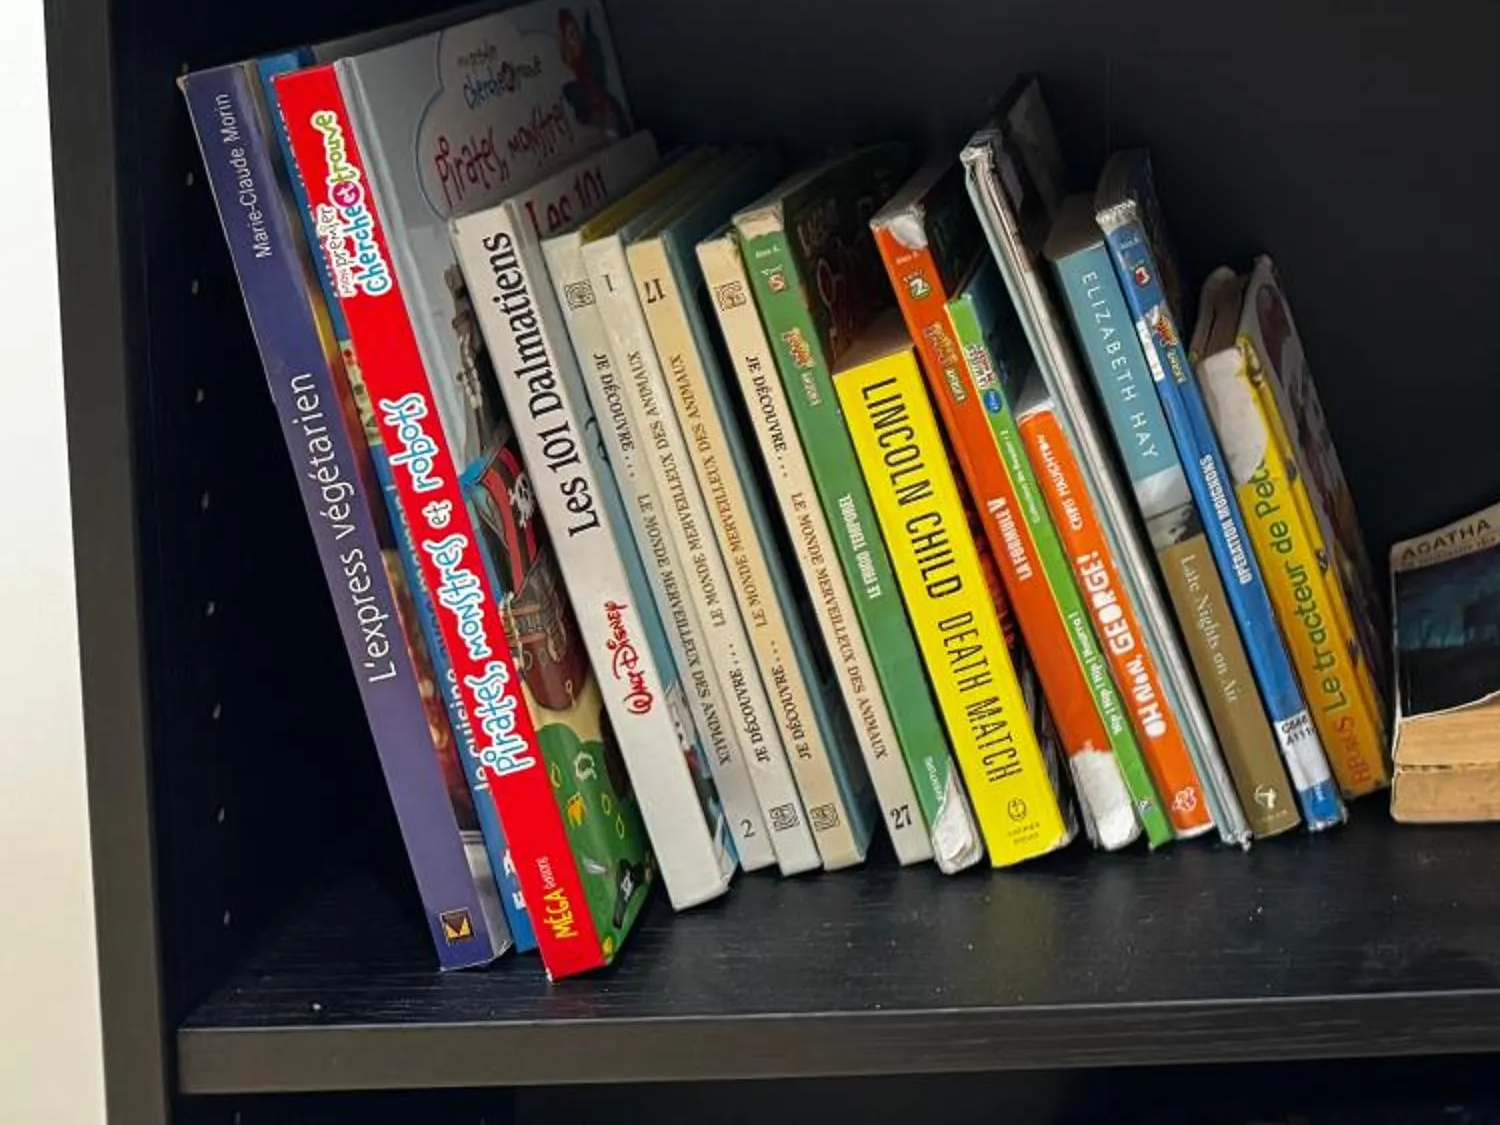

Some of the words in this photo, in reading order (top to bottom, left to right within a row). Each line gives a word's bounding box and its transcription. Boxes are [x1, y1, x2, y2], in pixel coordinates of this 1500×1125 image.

[216, 91, 242, 144] Morin
[310, 109, 358, 189] trouve
[230, 143, 272, 260] Marie-Claude
[483, 232, 563, 420] Dalmatiens
[626, 350, 660, 419] ANIMAUX
[669, 352, 702, 421] ANIMAUX
[744, 354, 762, 373] JE
[1082, 270, 1138, 403] ELIZABETH
[1130, 412, 1160, 461] HAY
[290, 373, 357, 544] végétarien
[538, 421, 583, 475] 101
[648, 420, 670, 458] DES
[691, 421, 712, 459] DES
[861, 375, 935, 507] LINCOLN
[422, 499, 453, 530] et
[560, 476, 601, 538] Les
[637, 493, 655, 514] LE
[789, 491, 806, 512] LE
[641, 516, 671, 570] MONDE
[796, 512, 826, 567] MONDE
[904, 510, 963, 601] CHILD
[1268, 520, 1296, 556] de
[1400, 516, 1492, 561] AGATHA
[692, 551, 721, 606] MONDE
[735, 553, 762, 607] MONDE
[1178, 553, 1200, 591] Late
[336, 547, 397, 684] L'express
[660, 567, 702, 670] MERVEILLEUX
[709, 609, 728, 628] LE
[815, 563, 856, 666] MERVEILLEUX
[1075, 549, 1137, 656] GEORGE!
[1192, 590, 1223, 651] Nights
[1283, 561, 1340, 675] tracteur
[936, 609, 994, 695] DEATH
[1212, 650, 1230, 677] on
[689, 669, 711, 703] DES
[846, 665, 867, 701] DES
[1220, 674, 1240, 704] Air
[1323, 675, 1348, 715] Le
[700, 703, 732, 767] ANIMAUX
[856, 698, 890, 761] ANIMAUX
[964, 695, 1023, 784] MATCH
[738, 817, 756, 839] 2
[888, 804, 914, 831] 27
